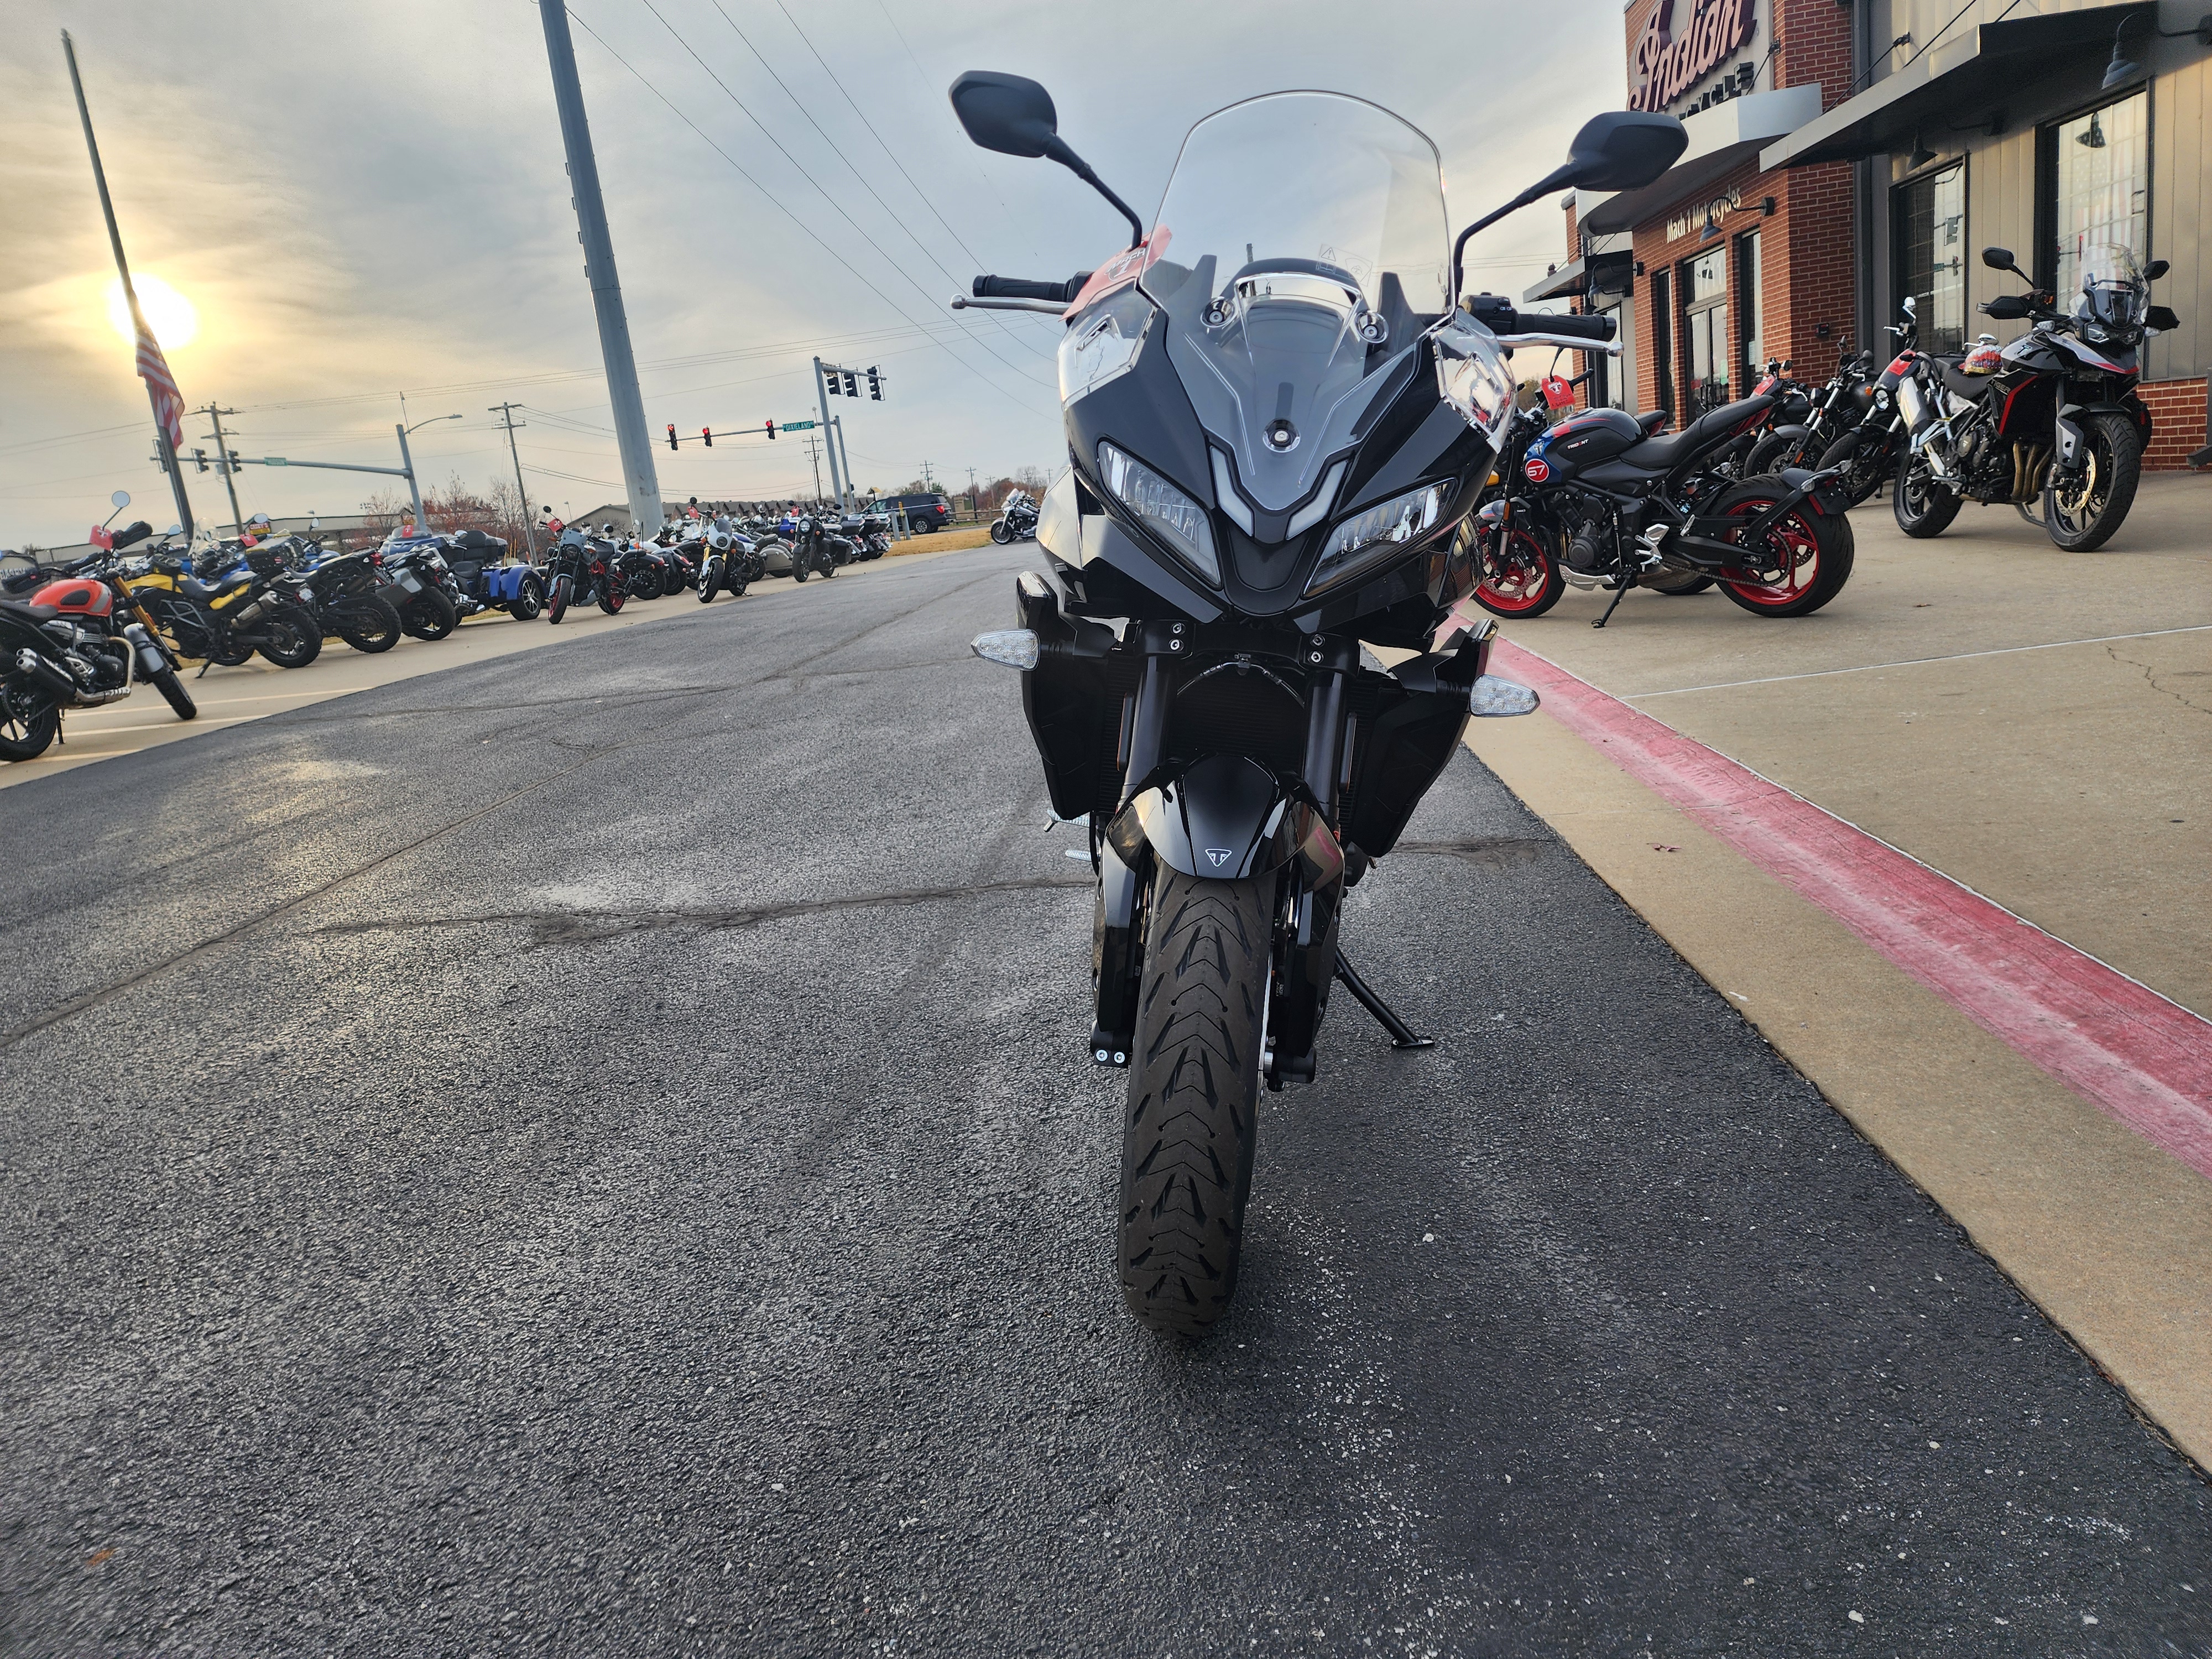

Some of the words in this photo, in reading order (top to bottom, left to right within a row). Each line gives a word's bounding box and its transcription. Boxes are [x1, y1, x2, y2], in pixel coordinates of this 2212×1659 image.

[1626, 0, 1744, 112] Indian
[1667, 212, 1685, 244] Mach
[1687, 209, 1691, 233] 1
[1105, 248, 1146, 274] MACH
[1114, 259, 1131, 278] 1
[1991, 379, 2011, 393] TIGER
[786, 422, 811, 431] DIXIELAND
[1527, 465, 1545, 477] 67
